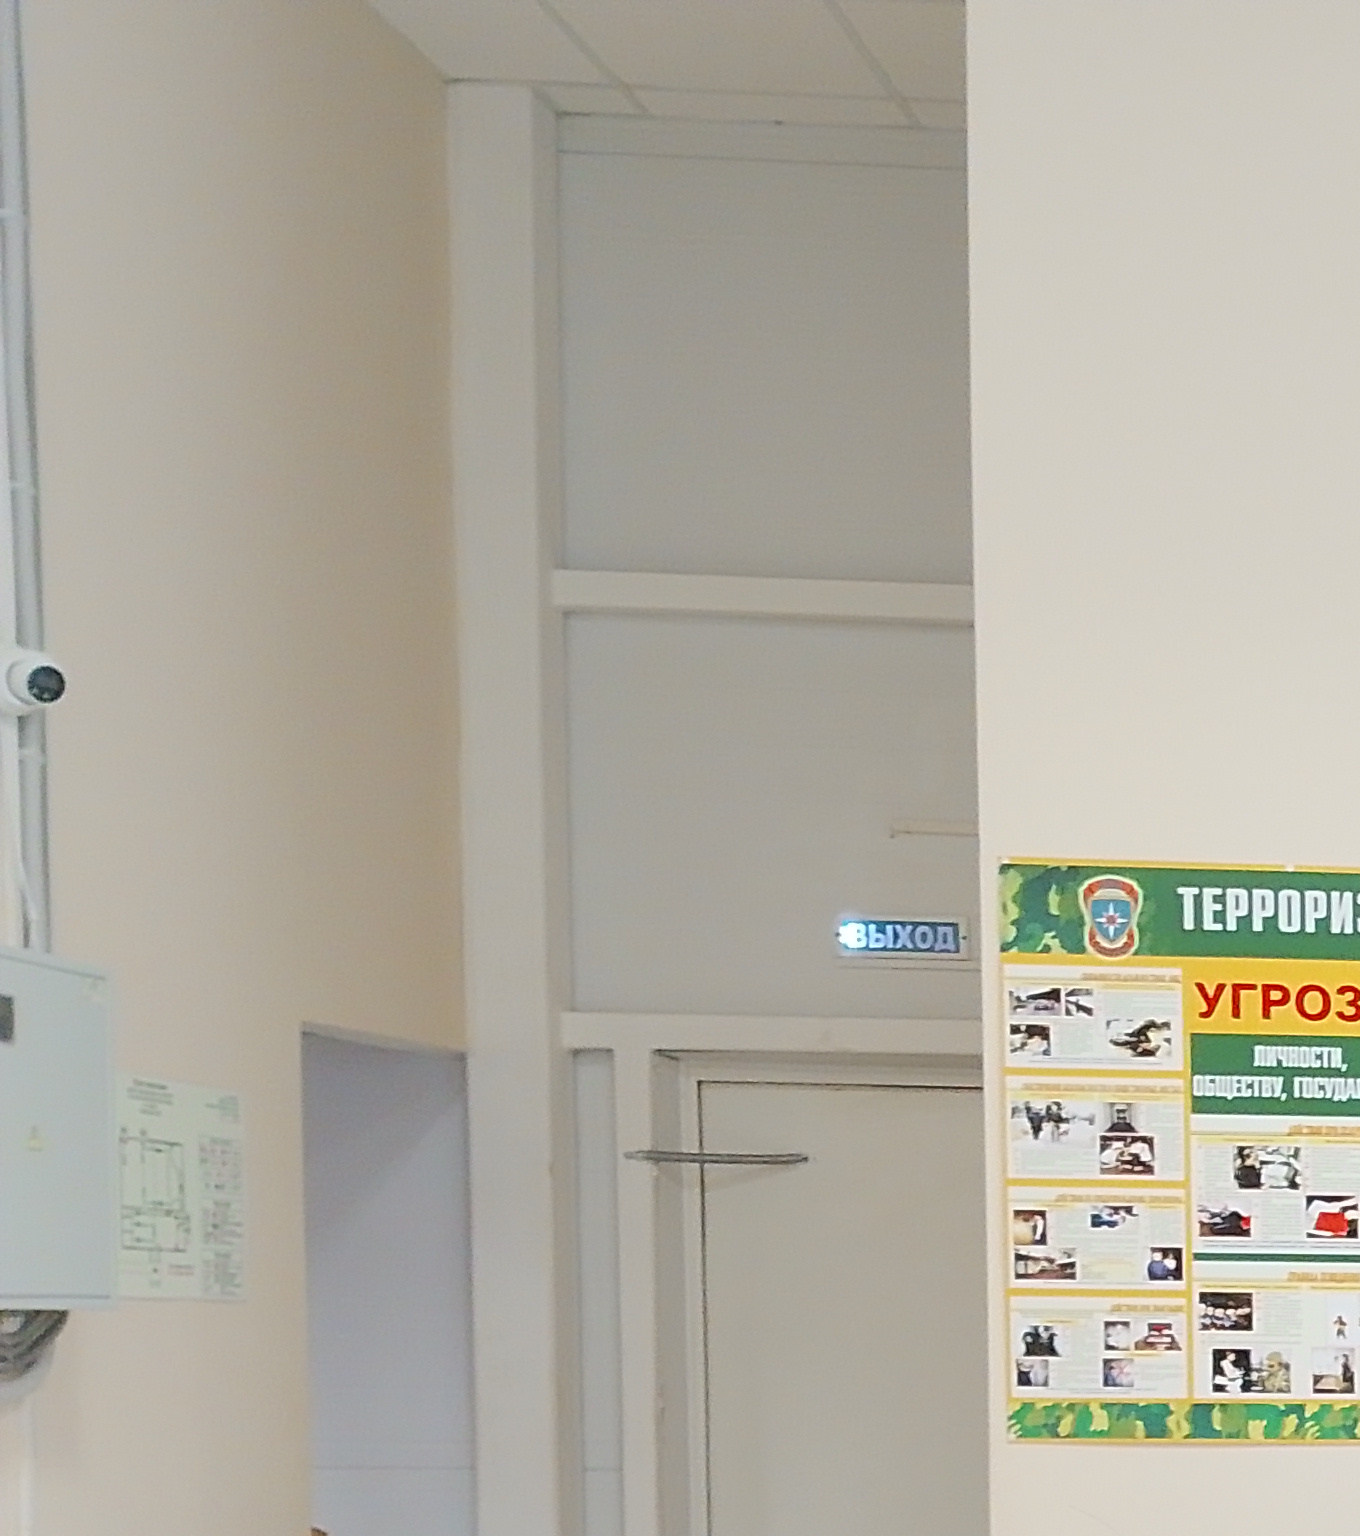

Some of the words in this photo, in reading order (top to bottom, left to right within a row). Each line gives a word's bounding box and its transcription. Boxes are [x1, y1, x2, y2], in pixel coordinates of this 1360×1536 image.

[844, 922, 956, 951] ВЫХОД
[1253, 1045, 1348, 1072] ЛИЧНОСТИ,
[1192, 1075, 1288, 1101] ОБЩЕСТВУ,
